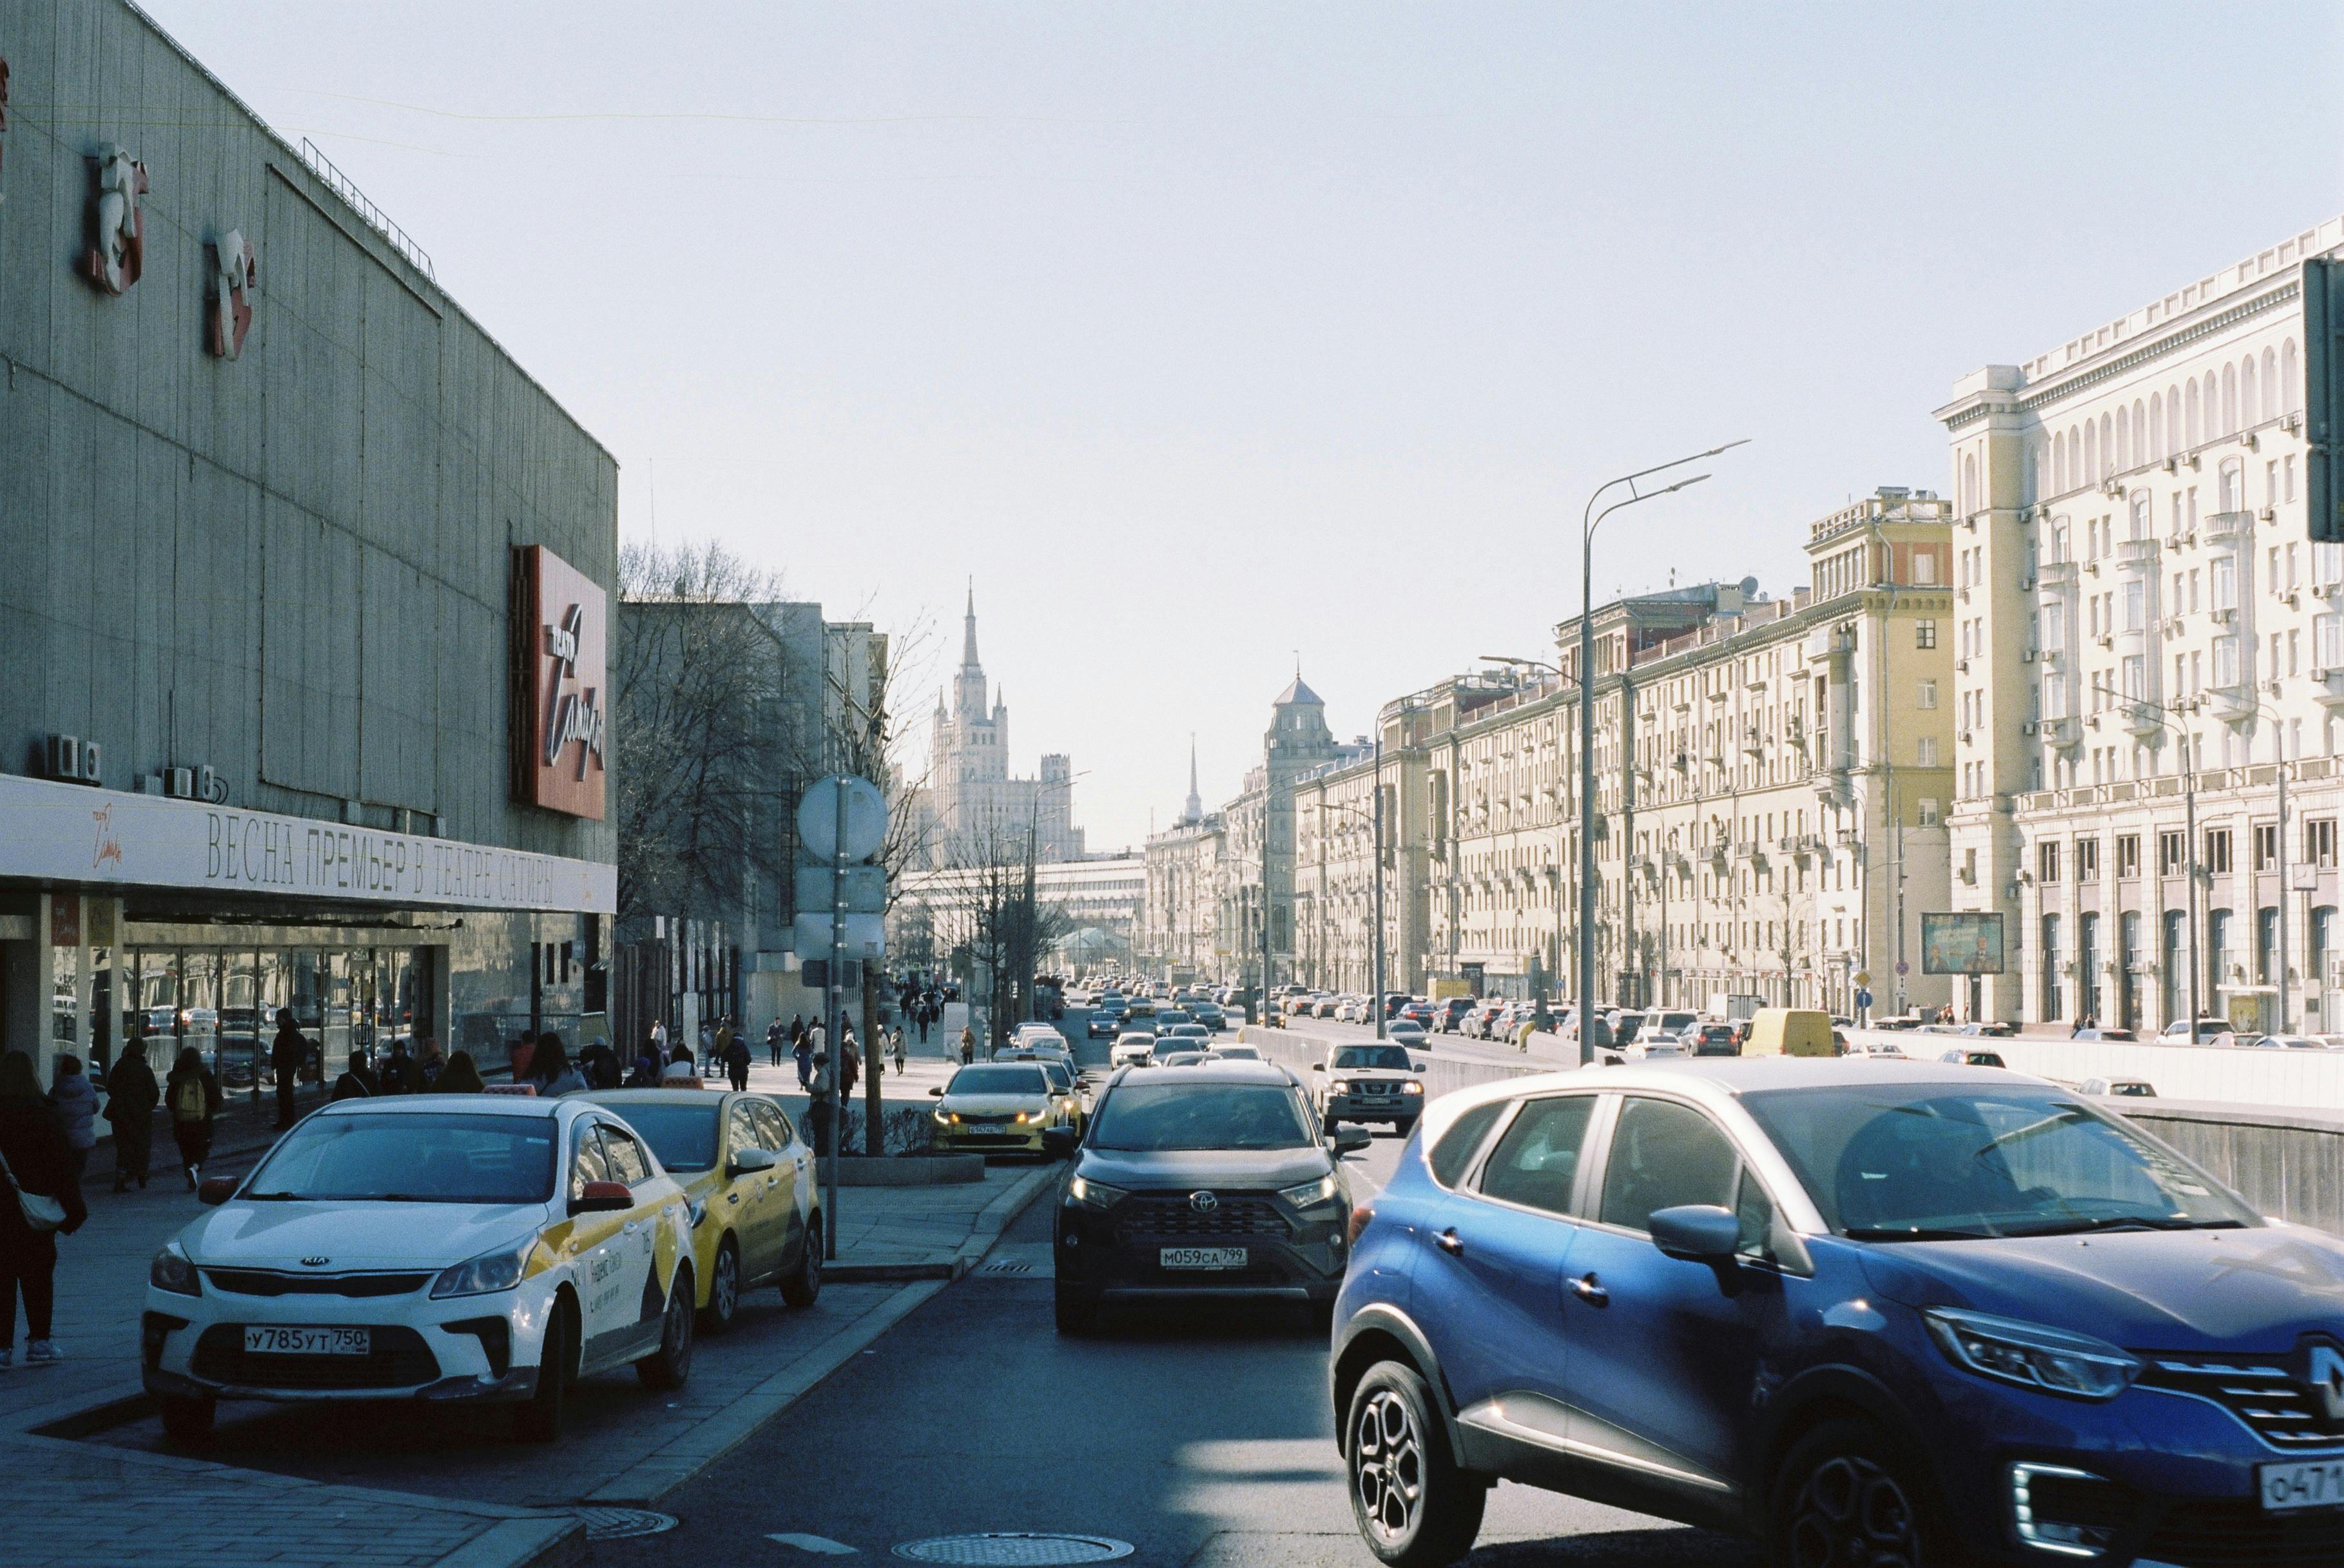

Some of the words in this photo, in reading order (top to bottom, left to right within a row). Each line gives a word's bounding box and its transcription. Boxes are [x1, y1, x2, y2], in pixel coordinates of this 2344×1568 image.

[206, 813, 295, 885] ВЕСНА
[306, 828, 406, 892] ПРЕМЬЕР
[414, 842, 424, 893] В
[433, 845, 492, 899] ТЕАТРЕ
[499, 854, 554, 903] САТИРЫ
[1222, 1248, 1243, 1259] 799
[333, 1330, 363, 1345] 750
